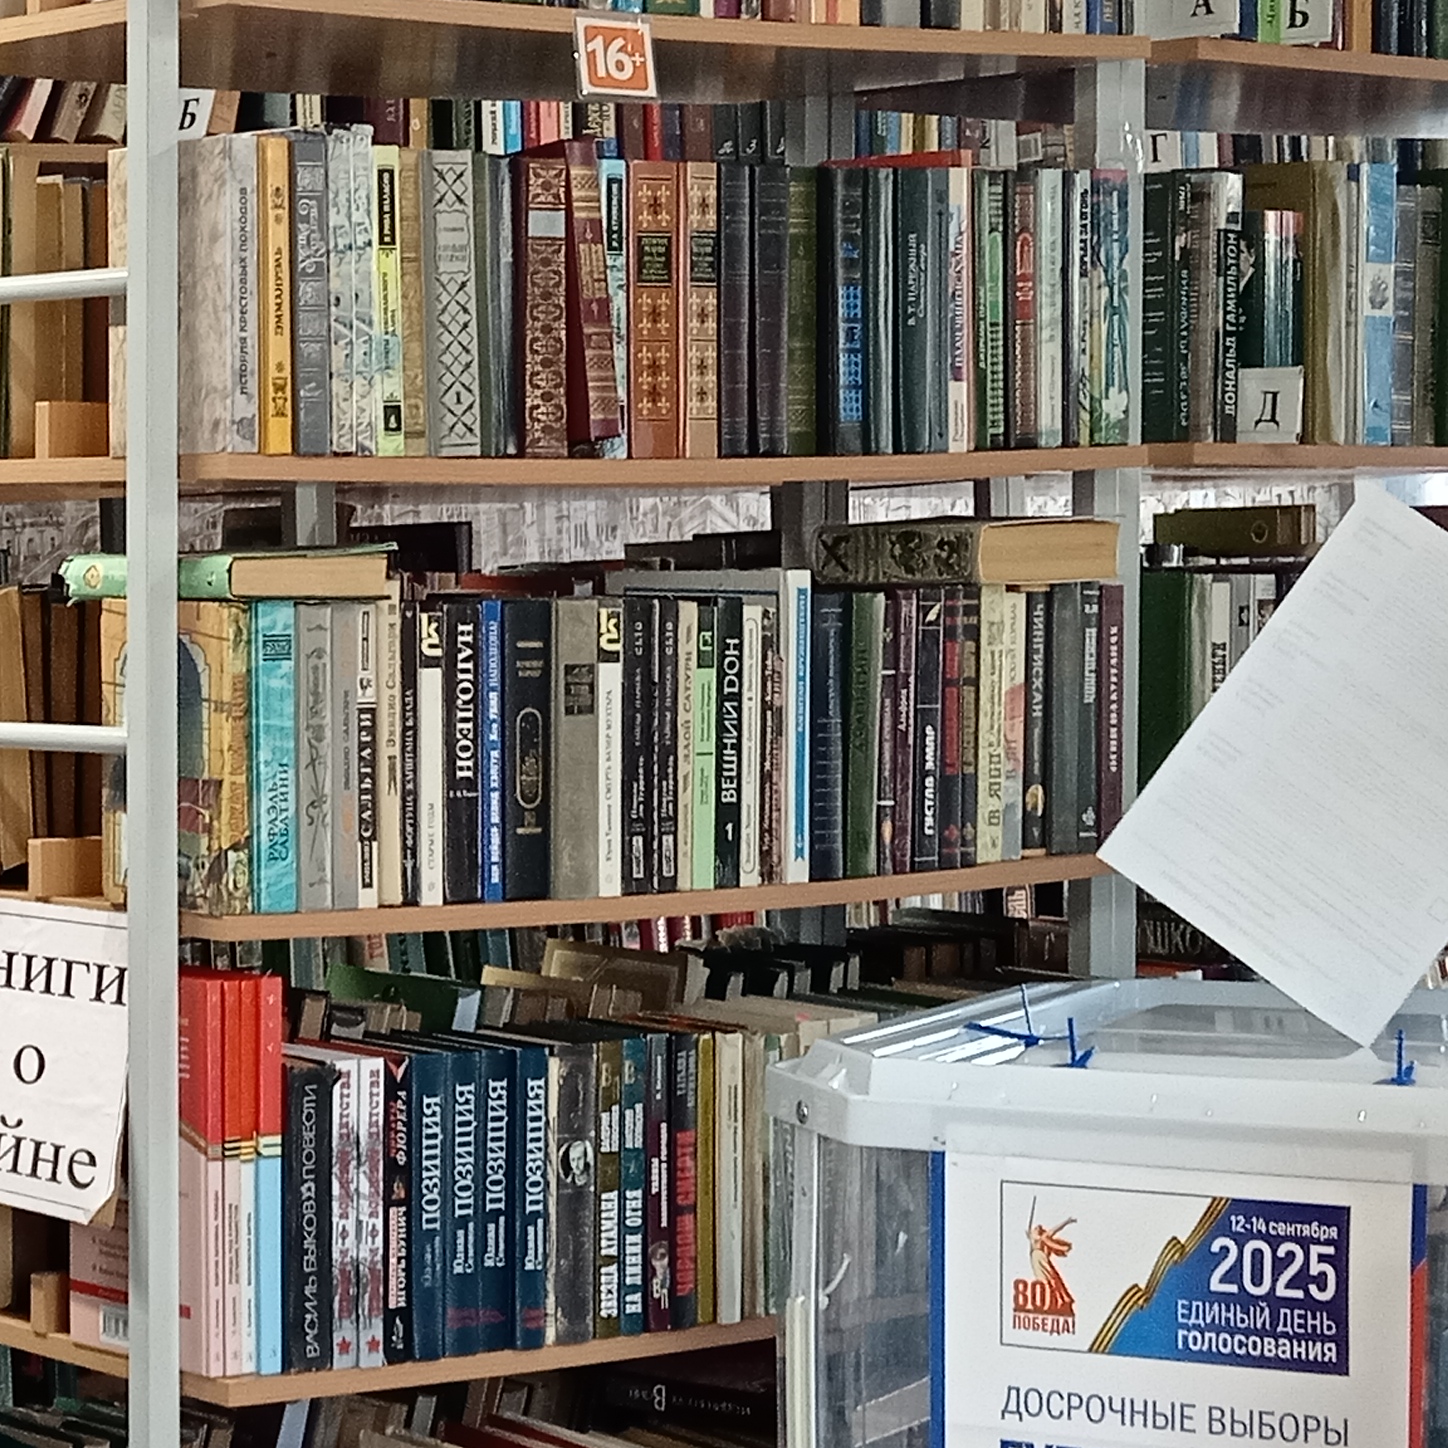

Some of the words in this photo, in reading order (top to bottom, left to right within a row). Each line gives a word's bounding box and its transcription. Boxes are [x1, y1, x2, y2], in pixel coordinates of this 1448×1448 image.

[586, 35, 645, 80] 16+
[177, 97, 200, 132] Б
[1149, 134, 1170, 162] Г
[239, 187, 248, 253] ПОХОДОВ
[239, 257, 248, 333] КРЕСТОВЫХ
[1223, 232, 1237, 331] ГАМИЛЬТОН
[239, 336, 248, 395] ИСТОРИЯ
[1224, 336, 1238, 416] ДОНАЛЬД
[1254, 390, 1282, 433] Д
[385, 622, 398, 690] Сальгари
[682, 651, 693, 713] САТУРН
[722, 637, 739, 695] ДОН
[1032, 603, 1044, 717] ЧИНГИСХАН
[385, 694, 397, 748] Эмилио
[454, 622, 475, 779] НАПОЛЕОН
[359, 712, 373, 838] САЛЬГАРИ
[721, 701, 739, 803] ВЕШНИЙ
[925, 724, 936, 770] ЭМАР
[266, 782, 279, 862] РАФАЭЛЬ
[278, 762, 290, 861] САБАТИНИ
[726, 822, 733, 841] 1
[925, 775, 936, 835] ГУСТАВ
[13, 1044, 46, 1084] о
[302, 1084, 318, 1181] ПОВЕСТИ
[395, 1090, 408, 1165] ФЮРЕРА
[453, 1082, 478, 1218] ПОЗИЦИЯ
[485, 1078, 509, 1212] ПОЗИЦИЯ
[524, 1077, 546, 1215] ПОЗИЦИЯ
[421, 1093, 445, 1230] ПОЗИЦИЯ
[302, 1200, 318, 1271] БЫКОВ
[395, 1206, 407, 1252] БУНИЧ
[599, 1189, 618, 1256] АТАМАНА
[624, 1188, 643, 1226] ОГНЯ
[1229, 1215, 1267, 1235] 12-14
[1268, 1217, 1338, 1242] сентября
[395, 1252, 407, 1308] ИГОРЬ
[600, 1263, 619, 1318] ЗВЕЗДА
[1012, 1278, 1048, 1312] 80
[1208, 1236, 1337, 1302] 2025
[303, 1275, 321, 1358] ВАСИЛЬ
[626, 1292, 643, 1314] НА
[1012, 1312, 1077, 1337] ПОБЕДА!
[1177, 1297, 1271, 1330] ЕДИНЫЙ
[1276, 1304, 1337, 1336] ДЕНЬ
[1177, 1328, 1338, 1364] ГОЛОСОВАНИЯ
[1001, 1384, 1197, 1436] ДОСРОЧНЫЕ
[1207, 1406, 1350, 1448] ВЫБОРЫ
